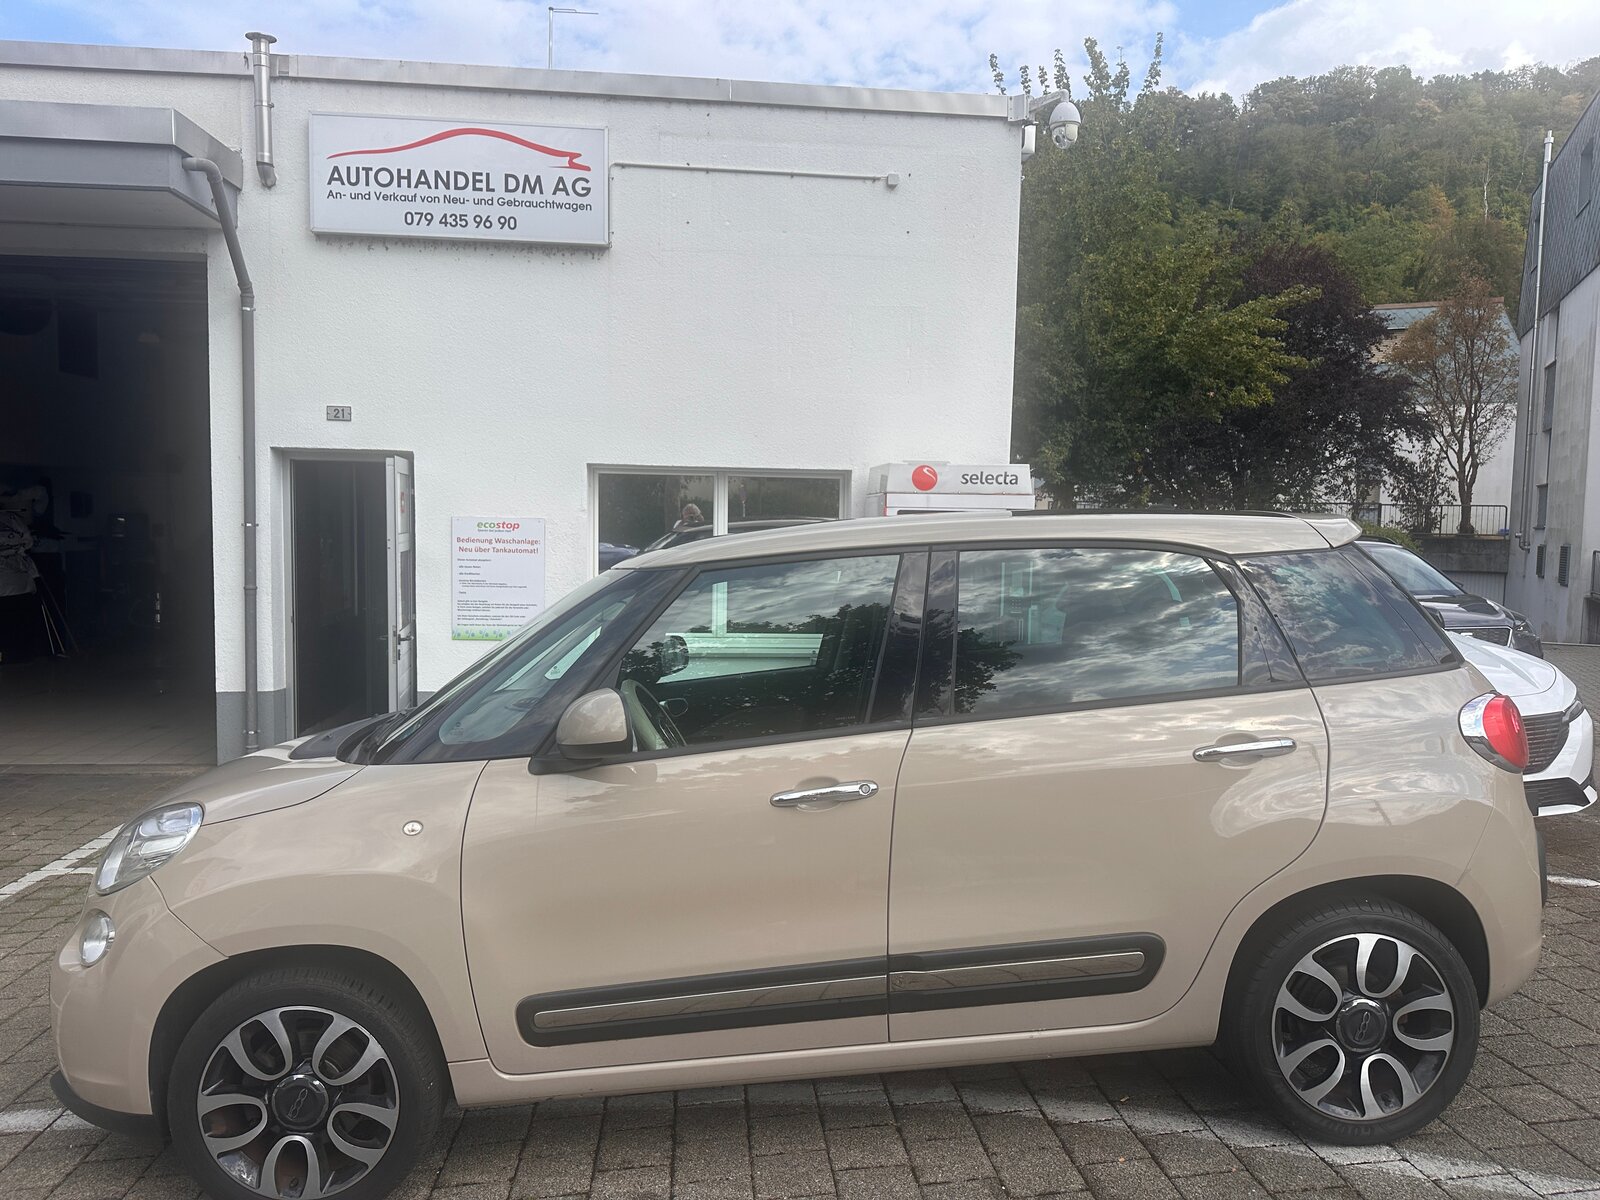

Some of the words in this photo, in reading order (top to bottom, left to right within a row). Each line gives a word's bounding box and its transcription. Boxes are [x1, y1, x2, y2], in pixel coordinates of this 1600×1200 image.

[327, 165, 496, 193] AUTOHANDEL
[504, 173, 544, 195] DM
[552, 176, 592, 198] AG
[327, 189, 347, 200] An-
[350, 190, 371, 201] und
[374, 191, 418, 203] Verkauf
[420, 195, 440, 204] von
[443, 194, 470, 205] Neu-
[473, 195, 494, 206] und
[497, 196, 592, 213] Gebrauchtwagen
[404, 212, 434, 227] 079
[439, 213, 469, 229] 435
[473, 214, 493, 229] 96
[497, 215, 517, 230] 90
[333, 408, 345, 419] 21
[961, 471, 1019, 486] selecta
[477, 521, 520, 531] ecostop
[456, 537, 493, 545] Bedienung
[494, 537, 541, 546] Waschanlage:
